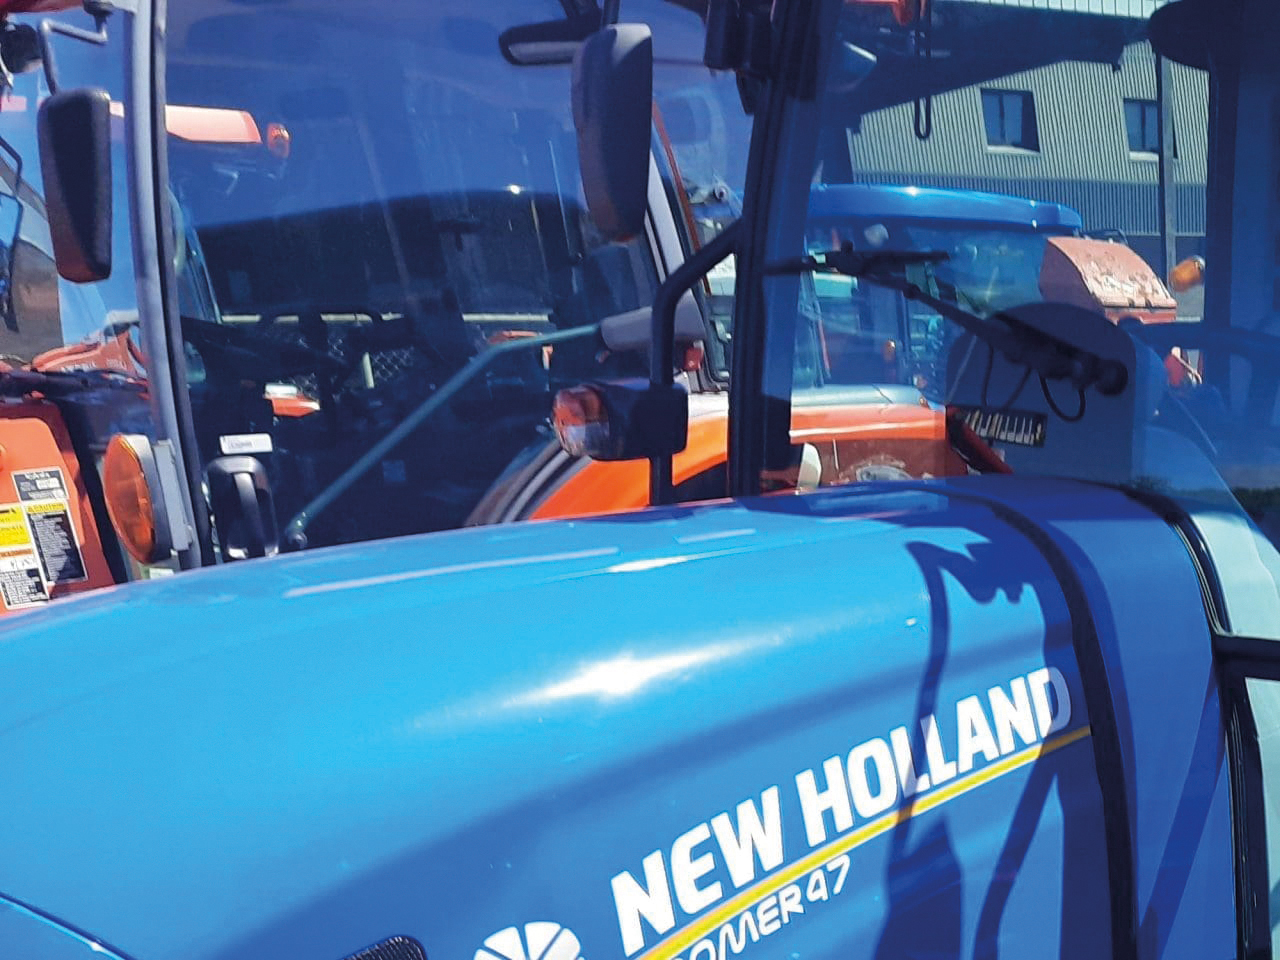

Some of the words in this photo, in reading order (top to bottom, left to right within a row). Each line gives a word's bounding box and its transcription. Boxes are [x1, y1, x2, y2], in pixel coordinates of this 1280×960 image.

[611, 786, 784, 957] NEW
[795, 666, 1072, 848] HOLLAND
[806, 854, 850, 903] 47
